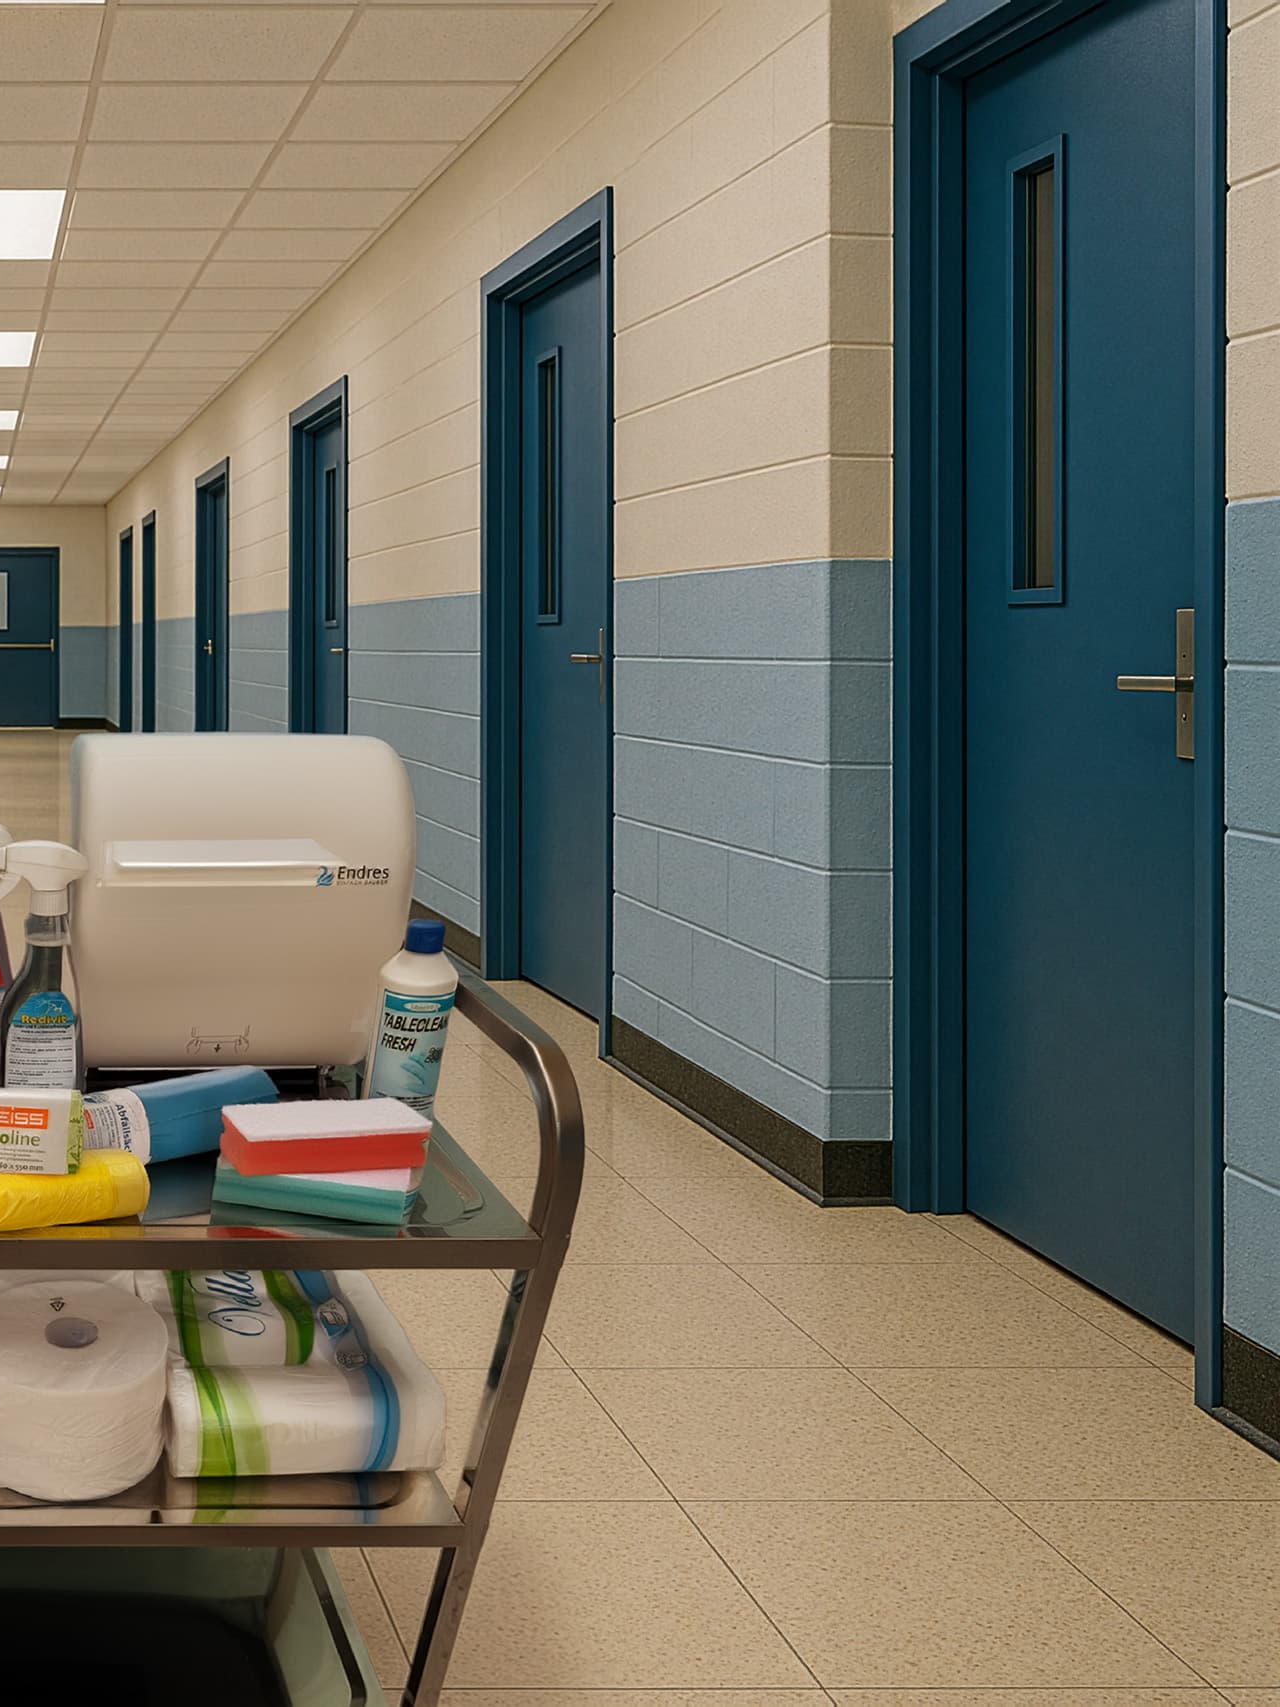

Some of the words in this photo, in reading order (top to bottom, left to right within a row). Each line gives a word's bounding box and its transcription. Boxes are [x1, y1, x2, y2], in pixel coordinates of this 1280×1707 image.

[337, 865, 390, 880] Endres
[21, 1014, 68, 1025] Redivit
[381, 1033, 417, 1053] FRESH
[115, 1103, 132, 1152] Abfallsäc
